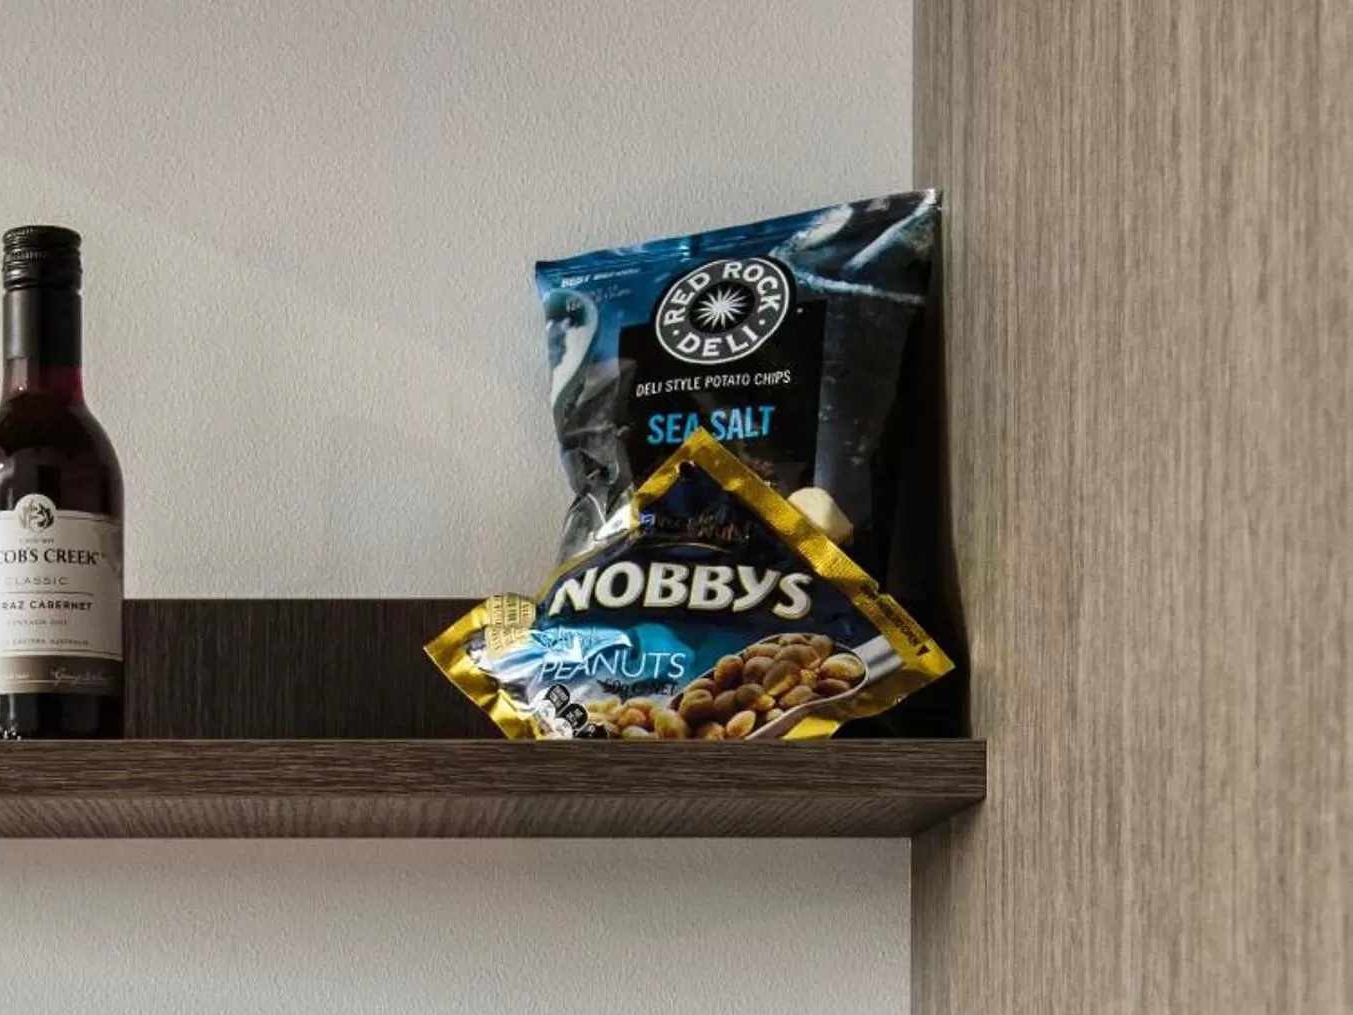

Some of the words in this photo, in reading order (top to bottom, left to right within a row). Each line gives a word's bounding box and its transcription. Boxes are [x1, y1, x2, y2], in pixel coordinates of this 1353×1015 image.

[664, 272, 711, 326] RED
[722, 261, 782, 313] ROCK
[676, 325, 758, 357] DELI
[636, 382, 662, 397] DELI
[665, 376, 701, 393] STYLE
[704, 373, 750, 389] POTATO
[754, 370, 791, 386] CHIPS
[647, 412, 699, 445] SEA
[710, 405, 775, 441] SALT
[44, 548, 98, 565] CREEK
[5, 576, 69, 586] CLASSIC
[30, 600, 93, 611] CABERNET
[538, 650, 686, 684] PEANUTS
